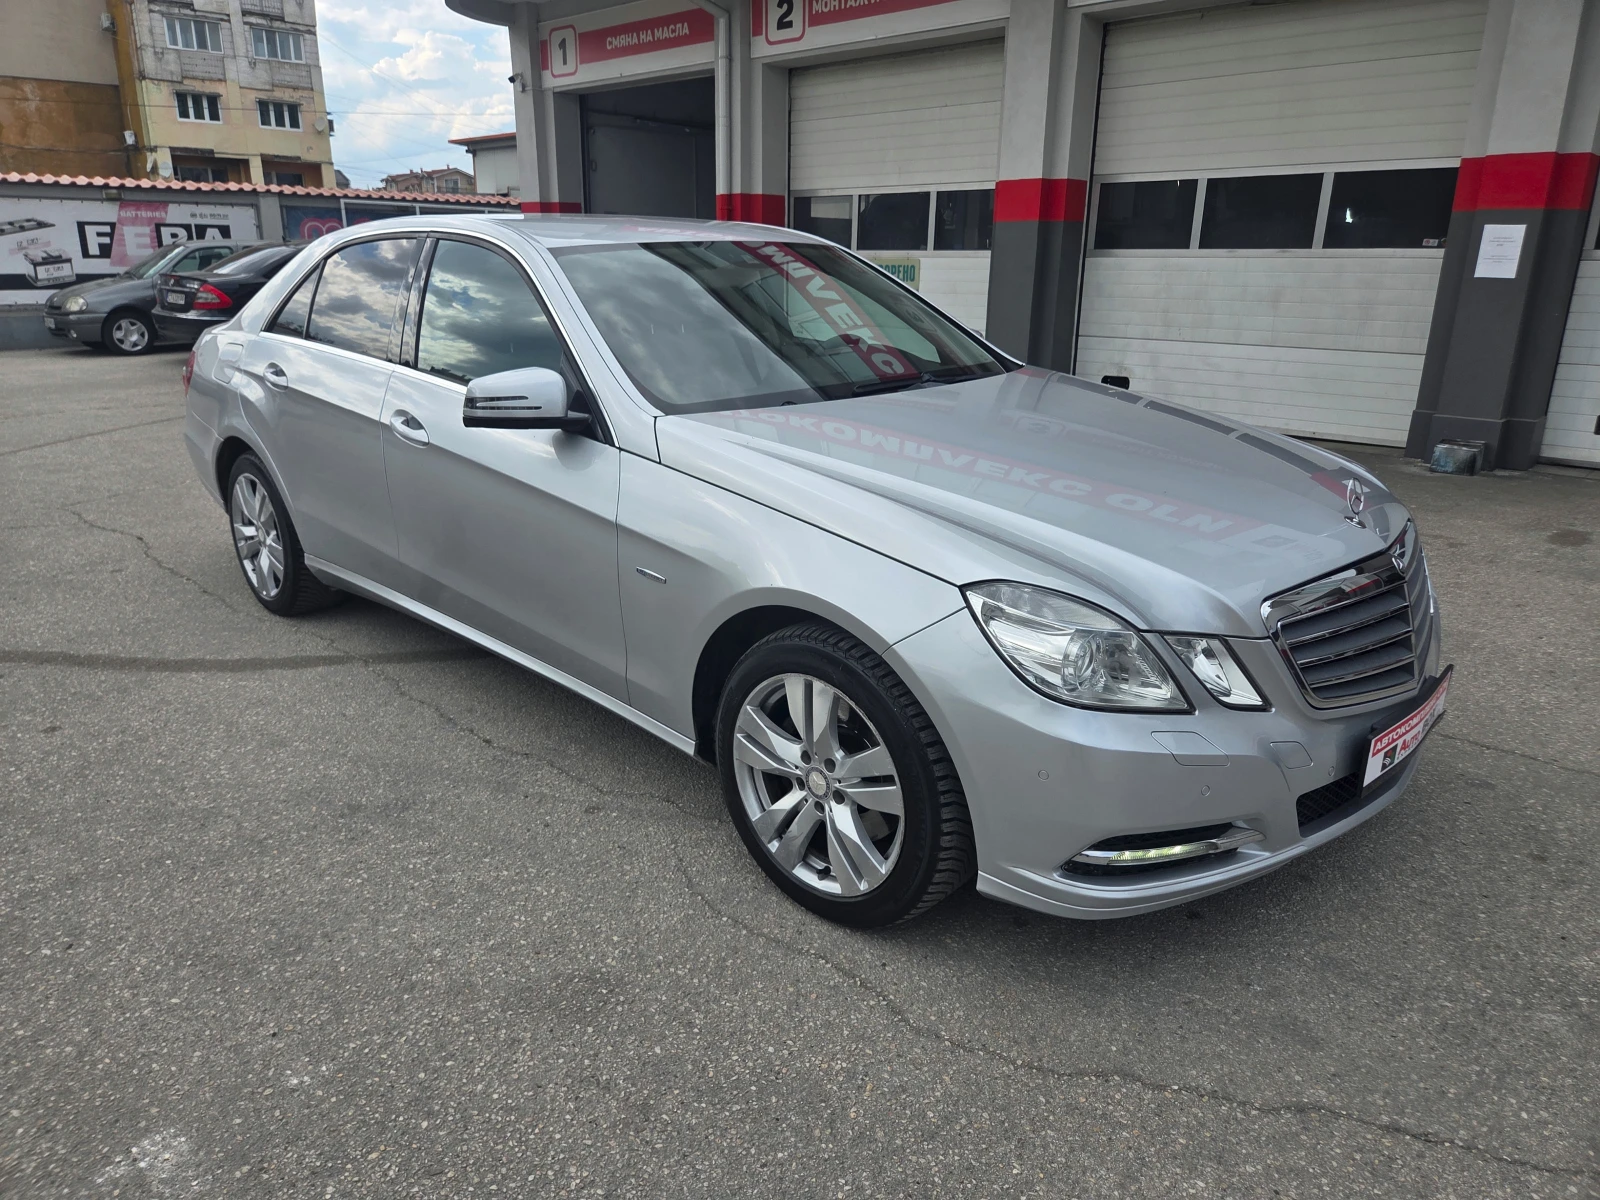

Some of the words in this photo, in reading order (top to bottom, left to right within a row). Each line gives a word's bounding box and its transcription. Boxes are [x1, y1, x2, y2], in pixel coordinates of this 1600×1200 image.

[776, 0, 794, 30] 2
[606, 32, 638, 50] СМЯНА
[639, 29, 653, 44] НА
[654, 22, 690, 41] МАСЛА
[558, 37, 568, 66] 1
[119, 210, 167, 218] BATTERIES
